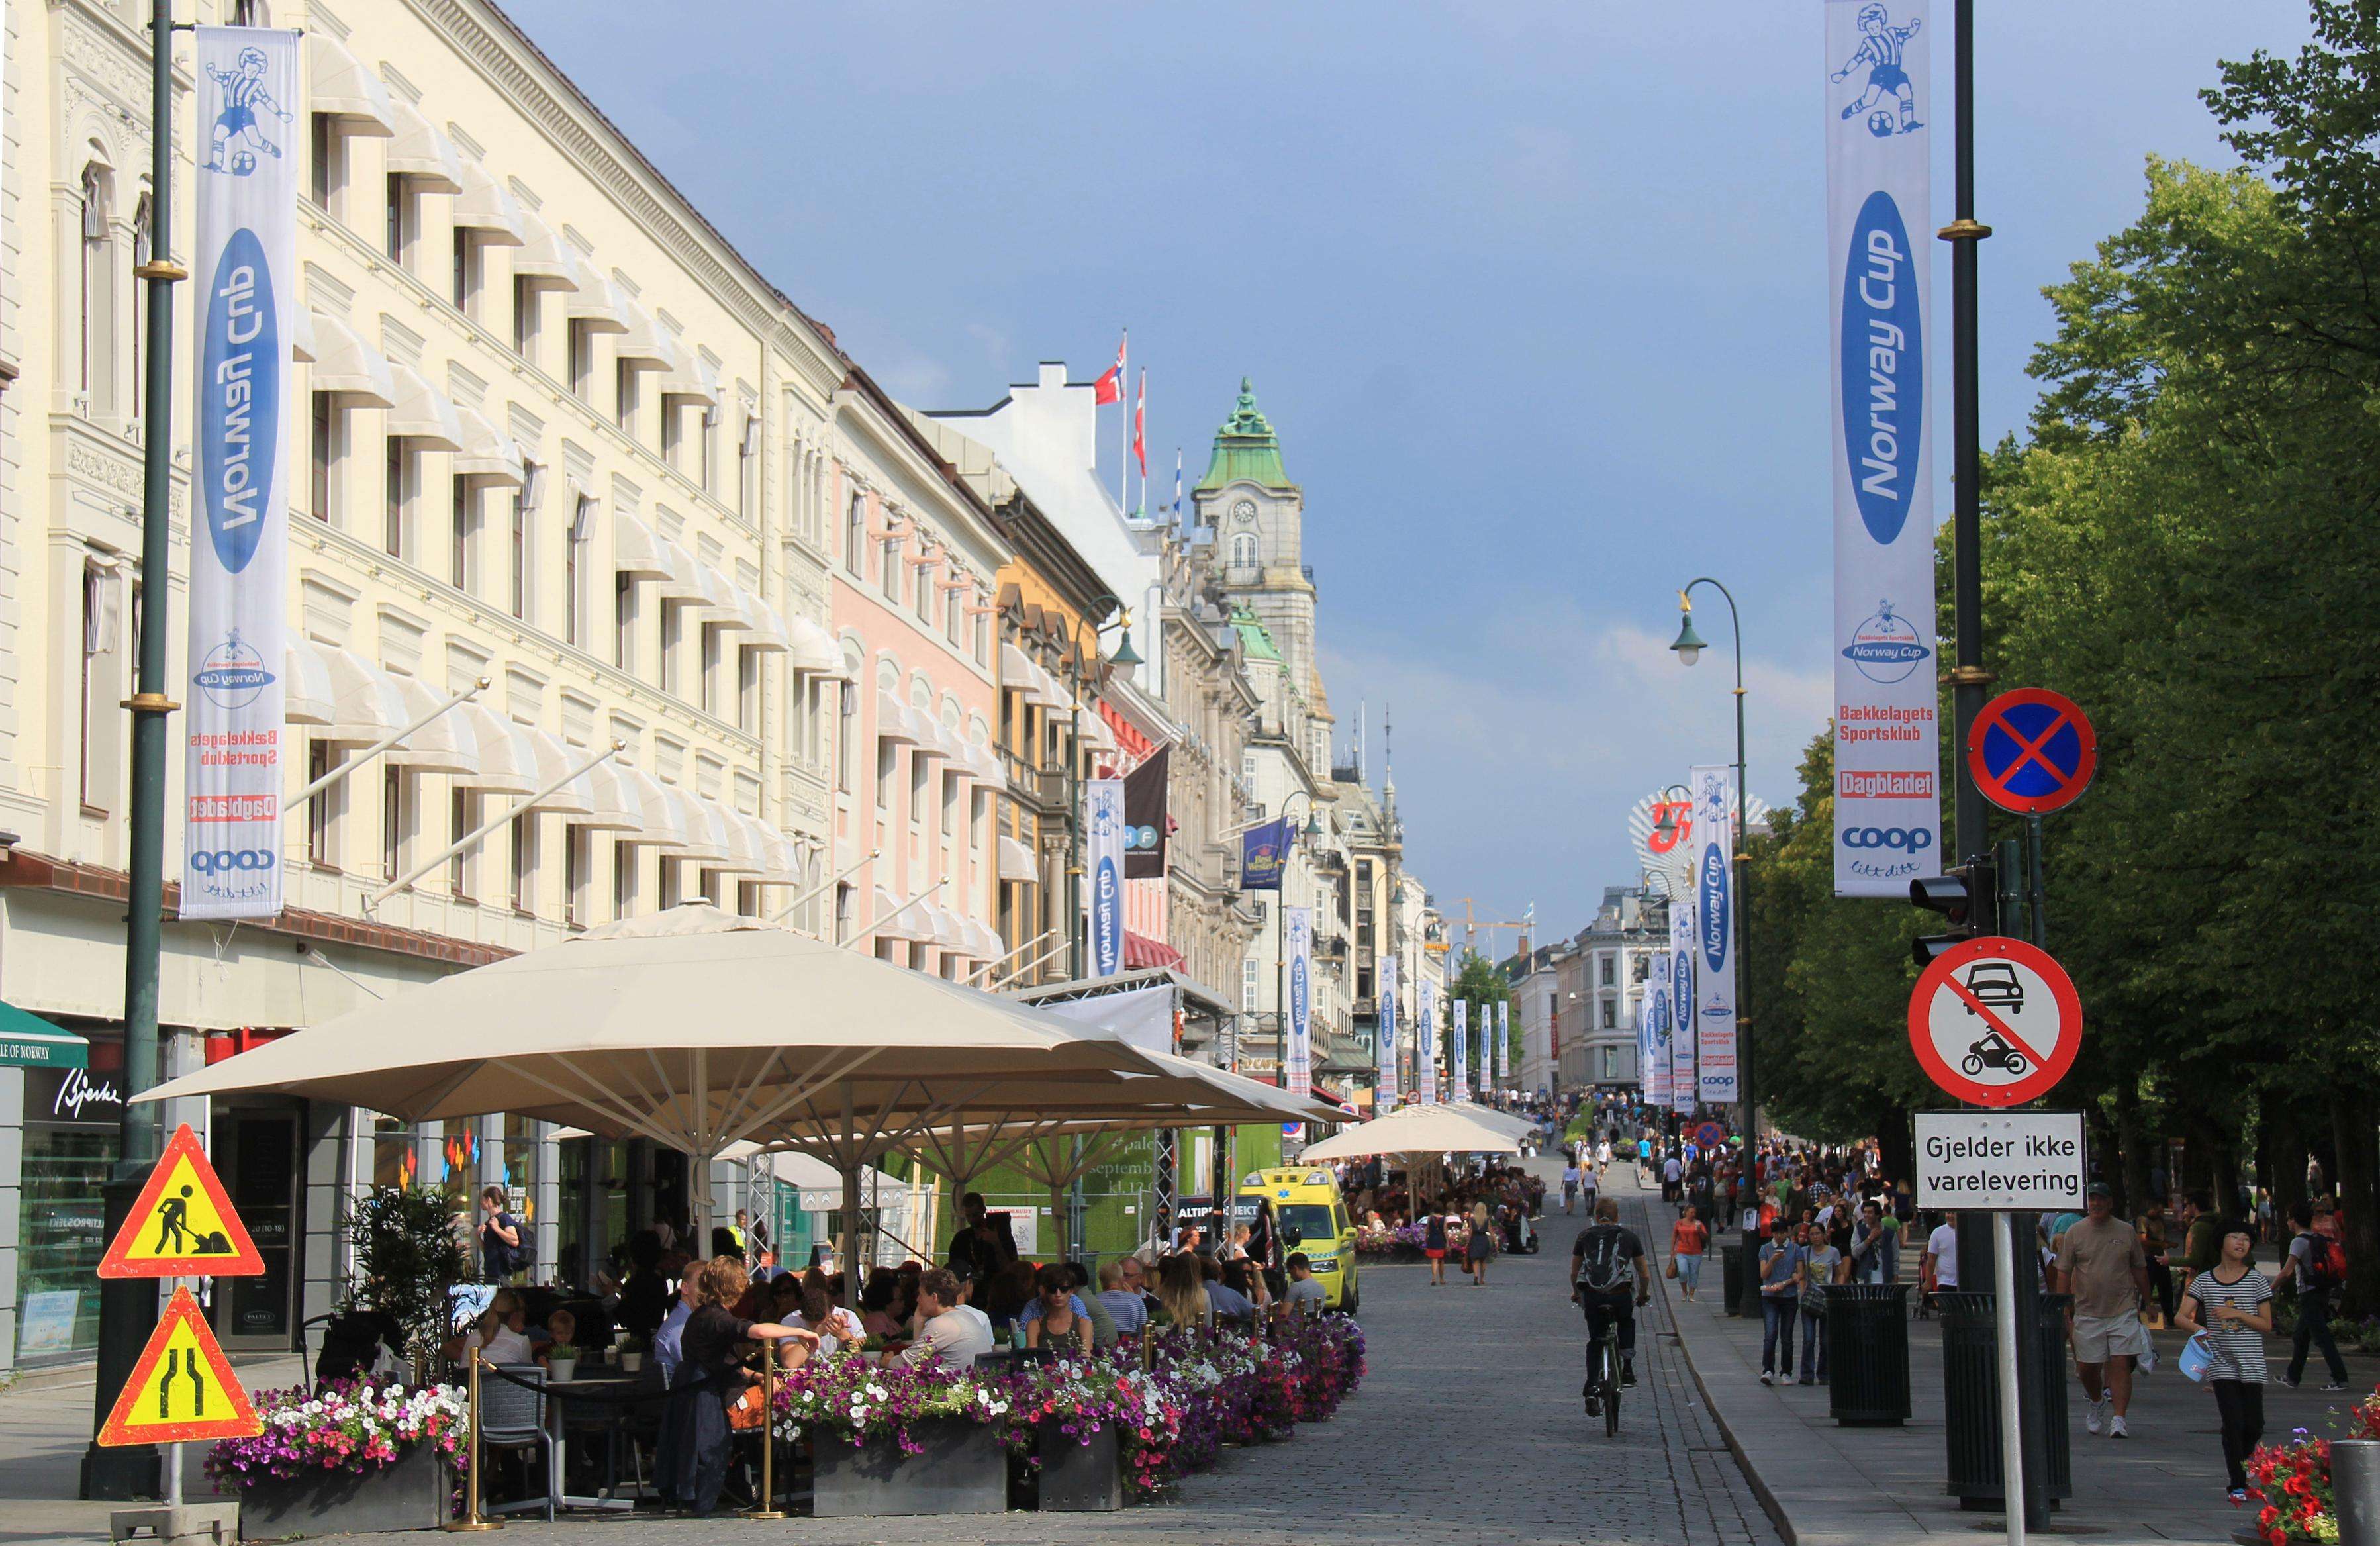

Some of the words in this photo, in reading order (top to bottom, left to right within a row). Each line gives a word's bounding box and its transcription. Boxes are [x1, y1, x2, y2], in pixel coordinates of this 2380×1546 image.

[1859, 230, 1903, 310] Cup
[1861, 318, 1905, 501] Norway
[1852, 646, 1899, 659] Norway
[1900, 647, 1921, 659] Cup
[1840, 705, 1933, 724] Bækkelagets
[1840, 725, 1921, 744] Sportsklub
[1841, 772, 1932, 798] Dagbladet
[1842, 827, 1932, 854] coop
[1706, 855, 1722, 887] Cup
[1707, 888, 1723, 957] Norway
[1678, 958, 1688, 977] Cup
[1678, 978, 1688, 1022] Norway
[10, 1045, 19, 1059] OF
[21, 1045, 50, 1060] NORWAY
[1702, 1075, 1735, 1087] coop
[1926, 1135, 2015, 1163] Gjelder
[2025, 1135, 2075, 1157] ikke
[1927, 1169, 2079, 1196] varelevering
